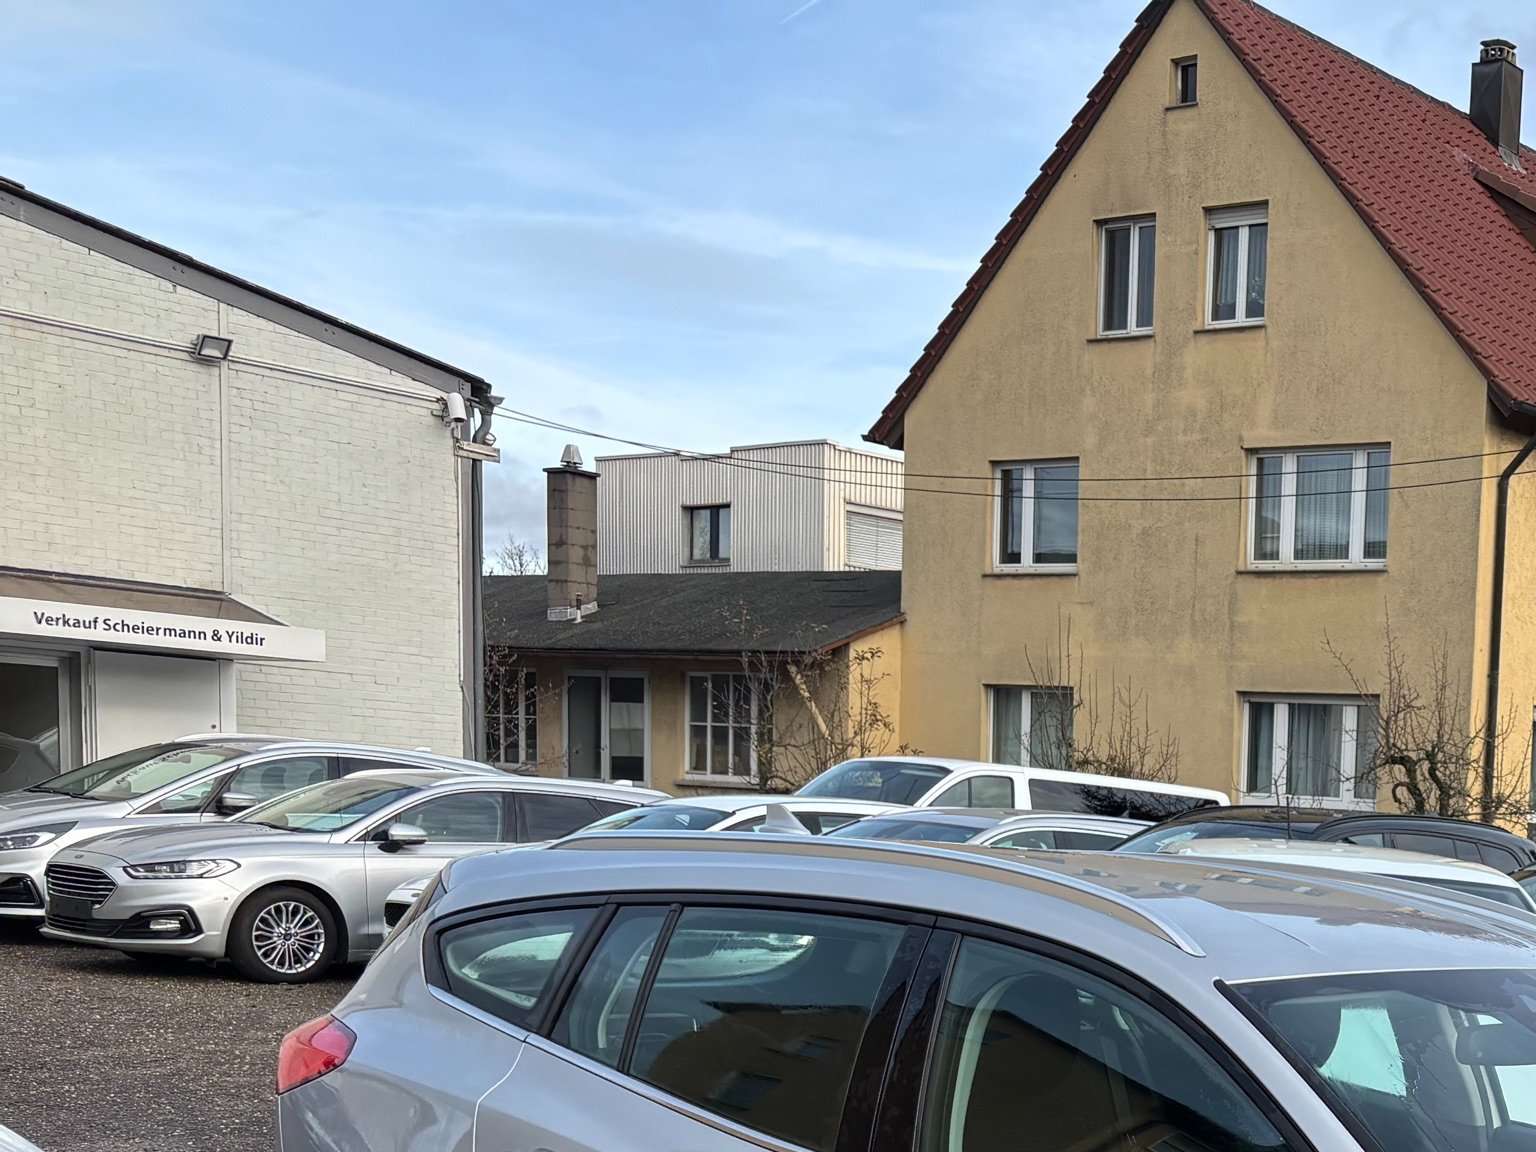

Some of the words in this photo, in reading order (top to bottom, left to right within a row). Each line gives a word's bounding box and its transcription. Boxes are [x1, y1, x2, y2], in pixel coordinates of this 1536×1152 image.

[33, 611, 98, 630] Verkauf
[103, 618, 207, 641] Scheiermann
[211, 629, 222, 643] &
[225, 629, 266, 647] Yildir
